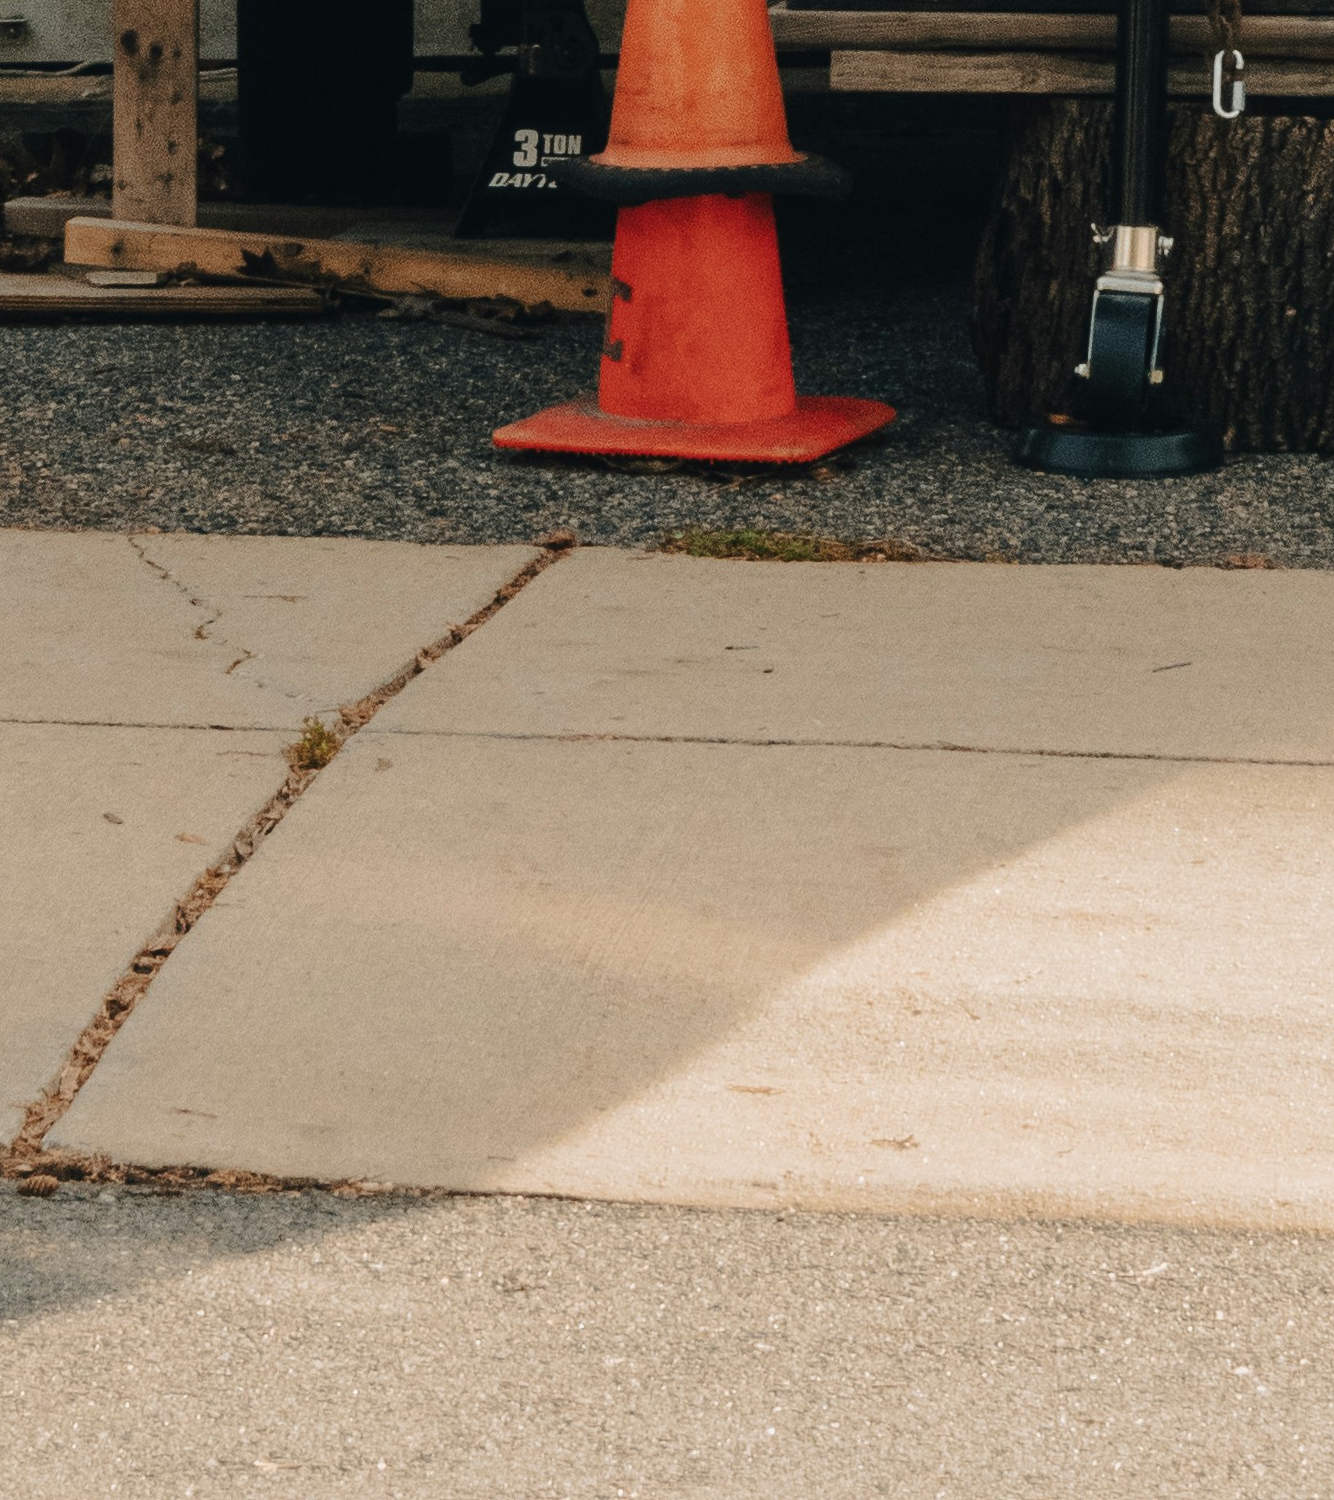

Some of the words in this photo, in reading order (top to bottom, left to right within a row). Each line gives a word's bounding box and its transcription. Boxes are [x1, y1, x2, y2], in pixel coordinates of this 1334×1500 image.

[514, 129, 538, 166] 3
[543, 134, 581, 154] TON
[489, 172, 557, 188] DAYT
